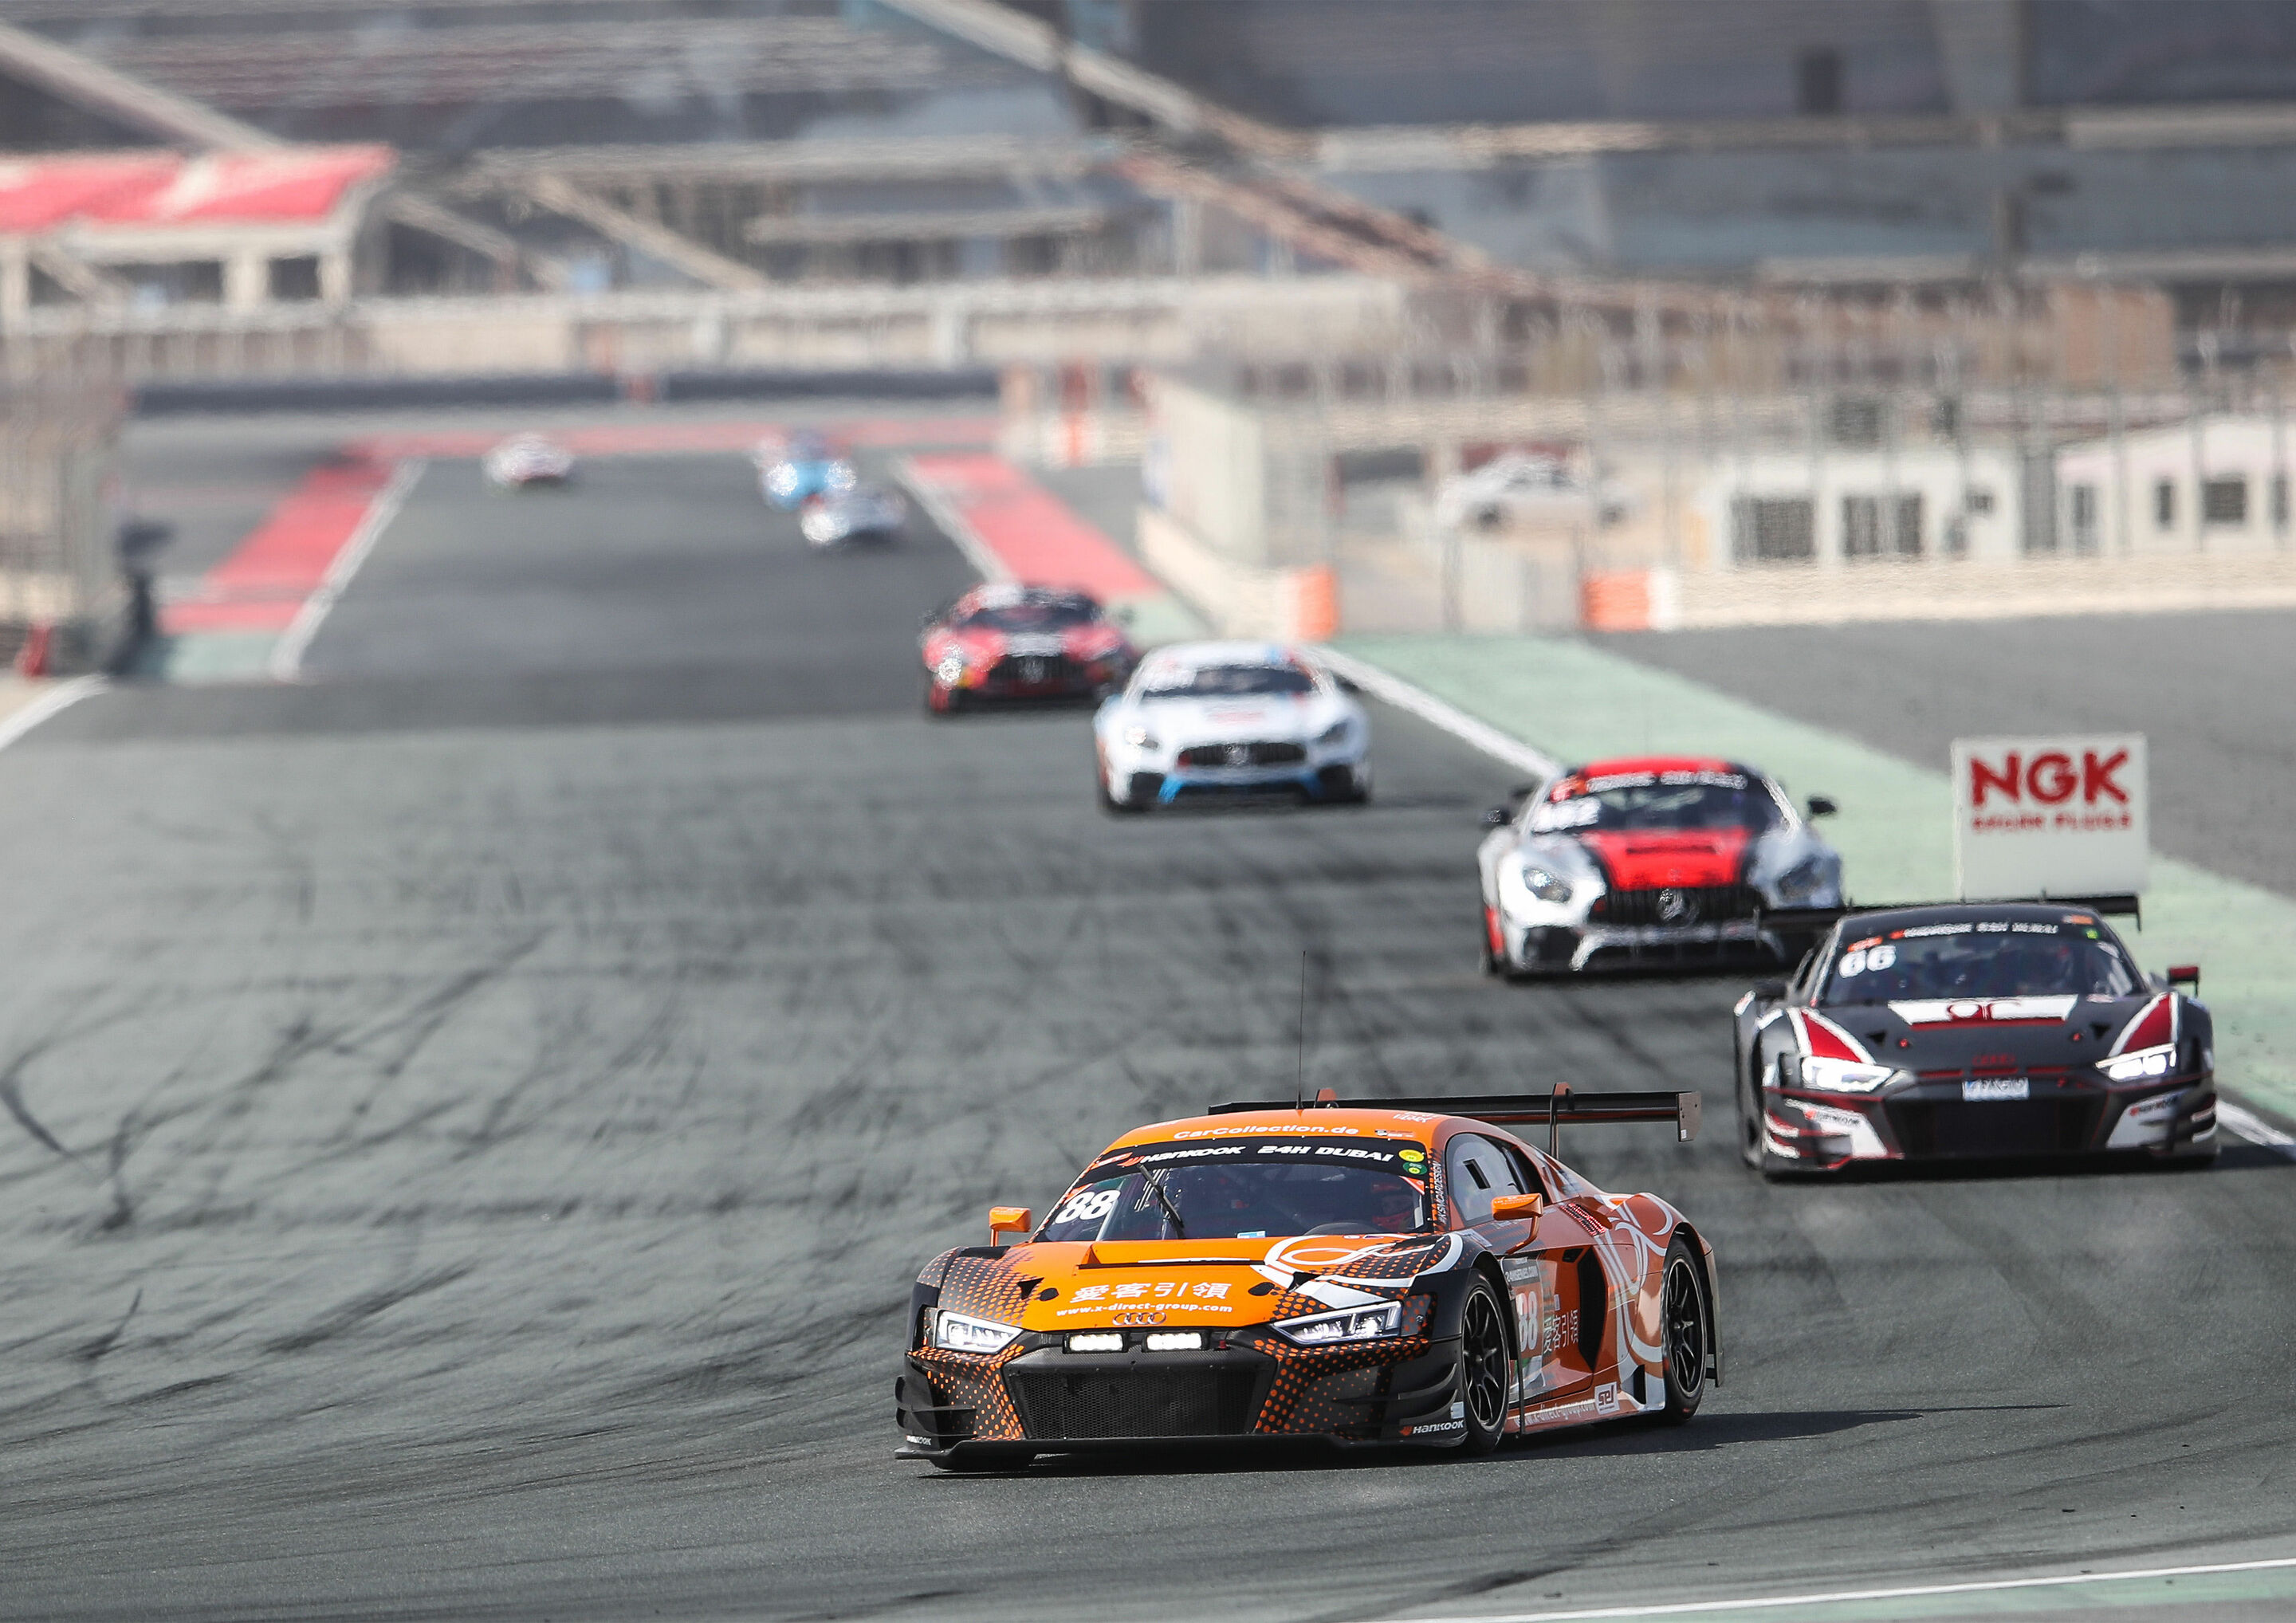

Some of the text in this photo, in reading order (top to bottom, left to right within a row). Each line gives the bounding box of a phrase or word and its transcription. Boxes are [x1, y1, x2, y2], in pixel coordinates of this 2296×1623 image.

[1971, 749, 2129, 807] NGK
[1838, 945, 1897, 979] 66
[1174, 1125, 1359, 1140] CarCollection.de
[1257, 1146, 1312, 1155] 24H
[1315, 1146, 1394, 1162] DUBAI
[1055, 1189, 1121, 1224] 88
[1069, 1282, 1233, 1304] 愛客引領
[1056, 1302, 1233, 1317] www.x-direct-group.com
